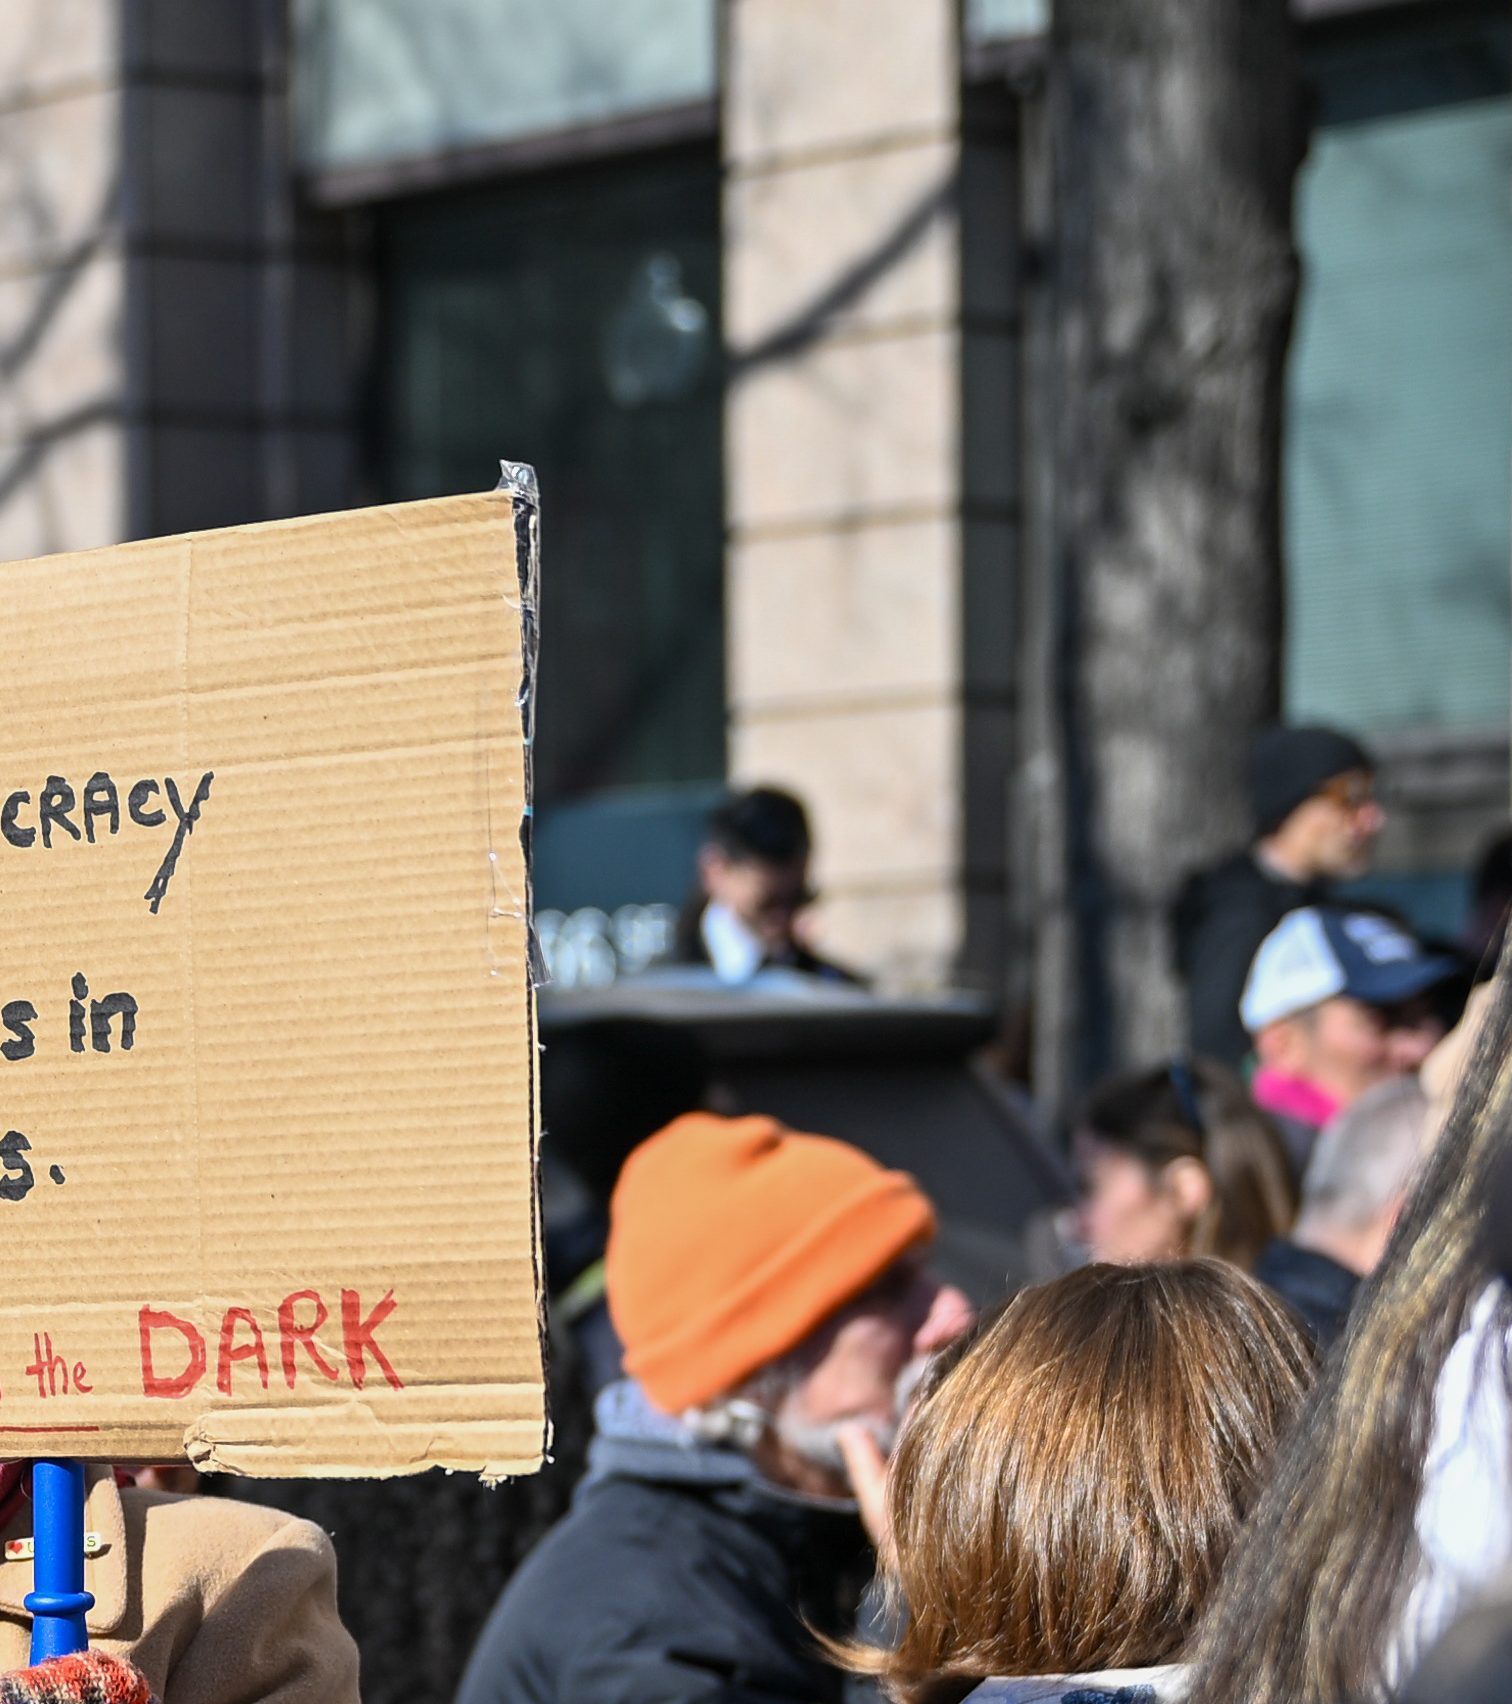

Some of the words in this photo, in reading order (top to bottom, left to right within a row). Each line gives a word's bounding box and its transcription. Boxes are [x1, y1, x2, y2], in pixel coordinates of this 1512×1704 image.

[69, 972, 139, 1053] in
[26, 1332, 93, 1397] the
[138, 1288, 404, 1397] DARK
